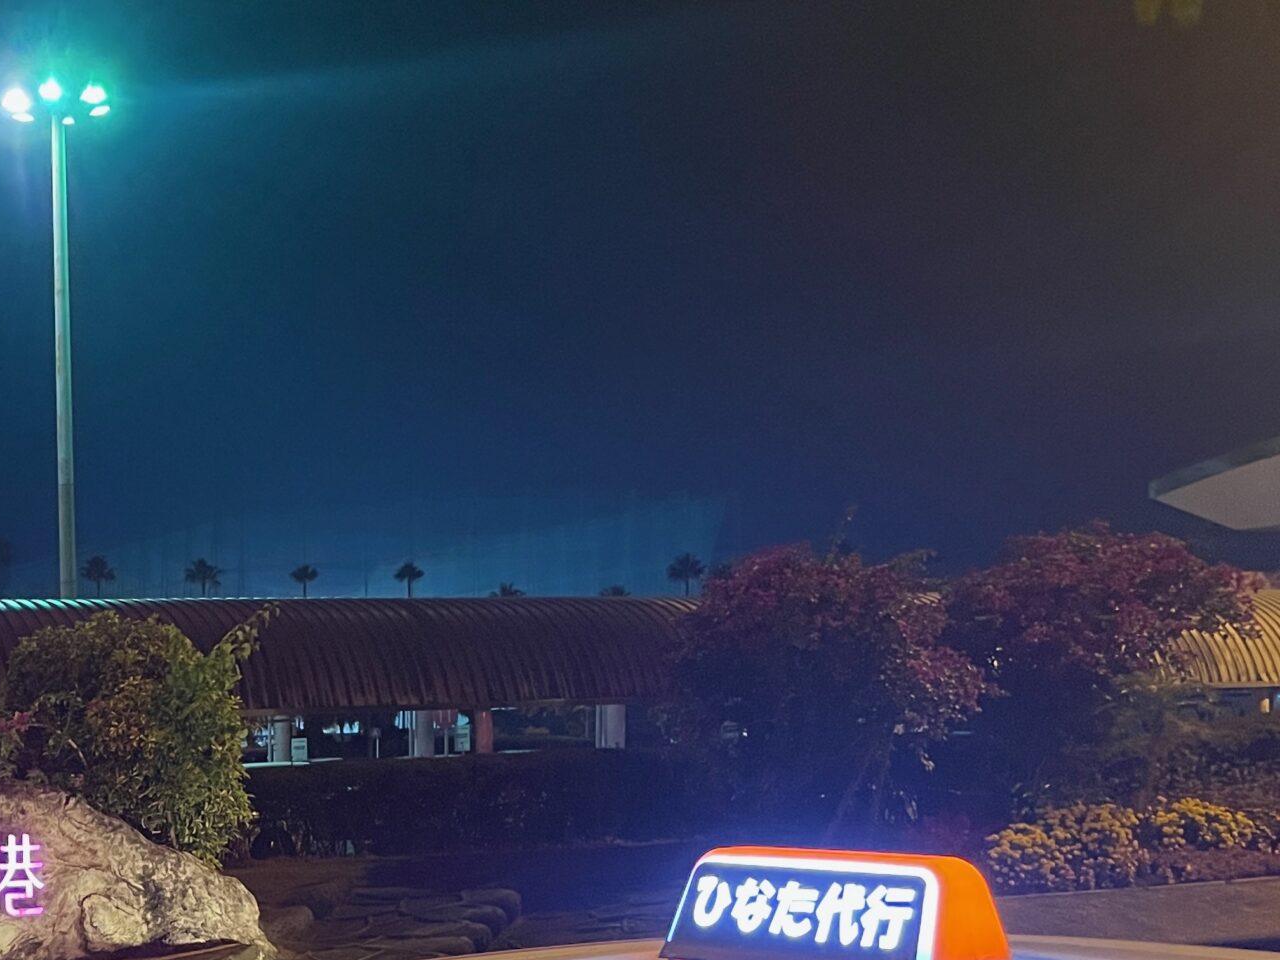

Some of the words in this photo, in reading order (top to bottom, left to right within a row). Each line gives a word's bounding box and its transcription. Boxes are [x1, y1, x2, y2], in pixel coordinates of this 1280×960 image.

[693, 875, 917, 950] ひなた代行
